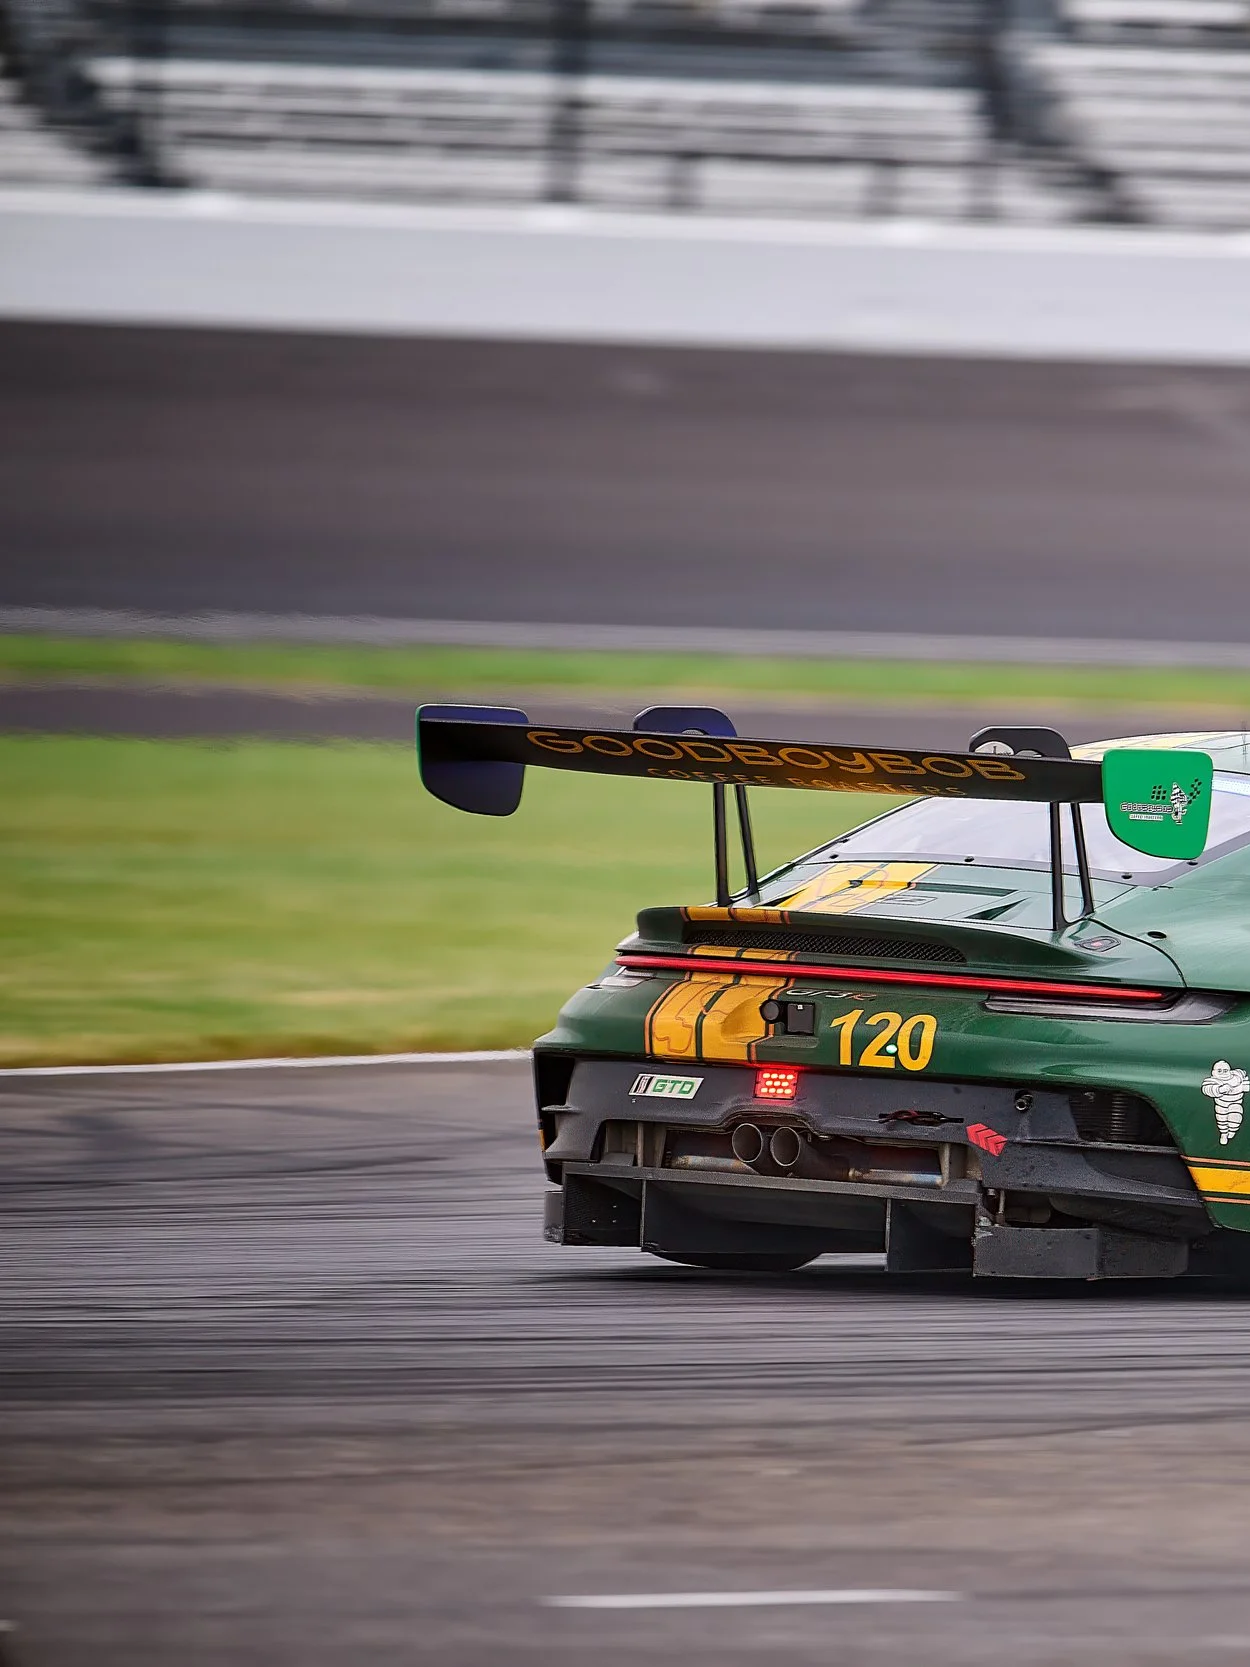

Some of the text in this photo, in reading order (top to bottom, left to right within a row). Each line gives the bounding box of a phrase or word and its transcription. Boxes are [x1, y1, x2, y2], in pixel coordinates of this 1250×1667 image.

[526, 731, 1026, 780] GOODBOYBOB
[647, 767, 777, 786] COFFEE
[829, 1009, 938, 1072] 120
[652, 1078, 696, 1095] GTD
